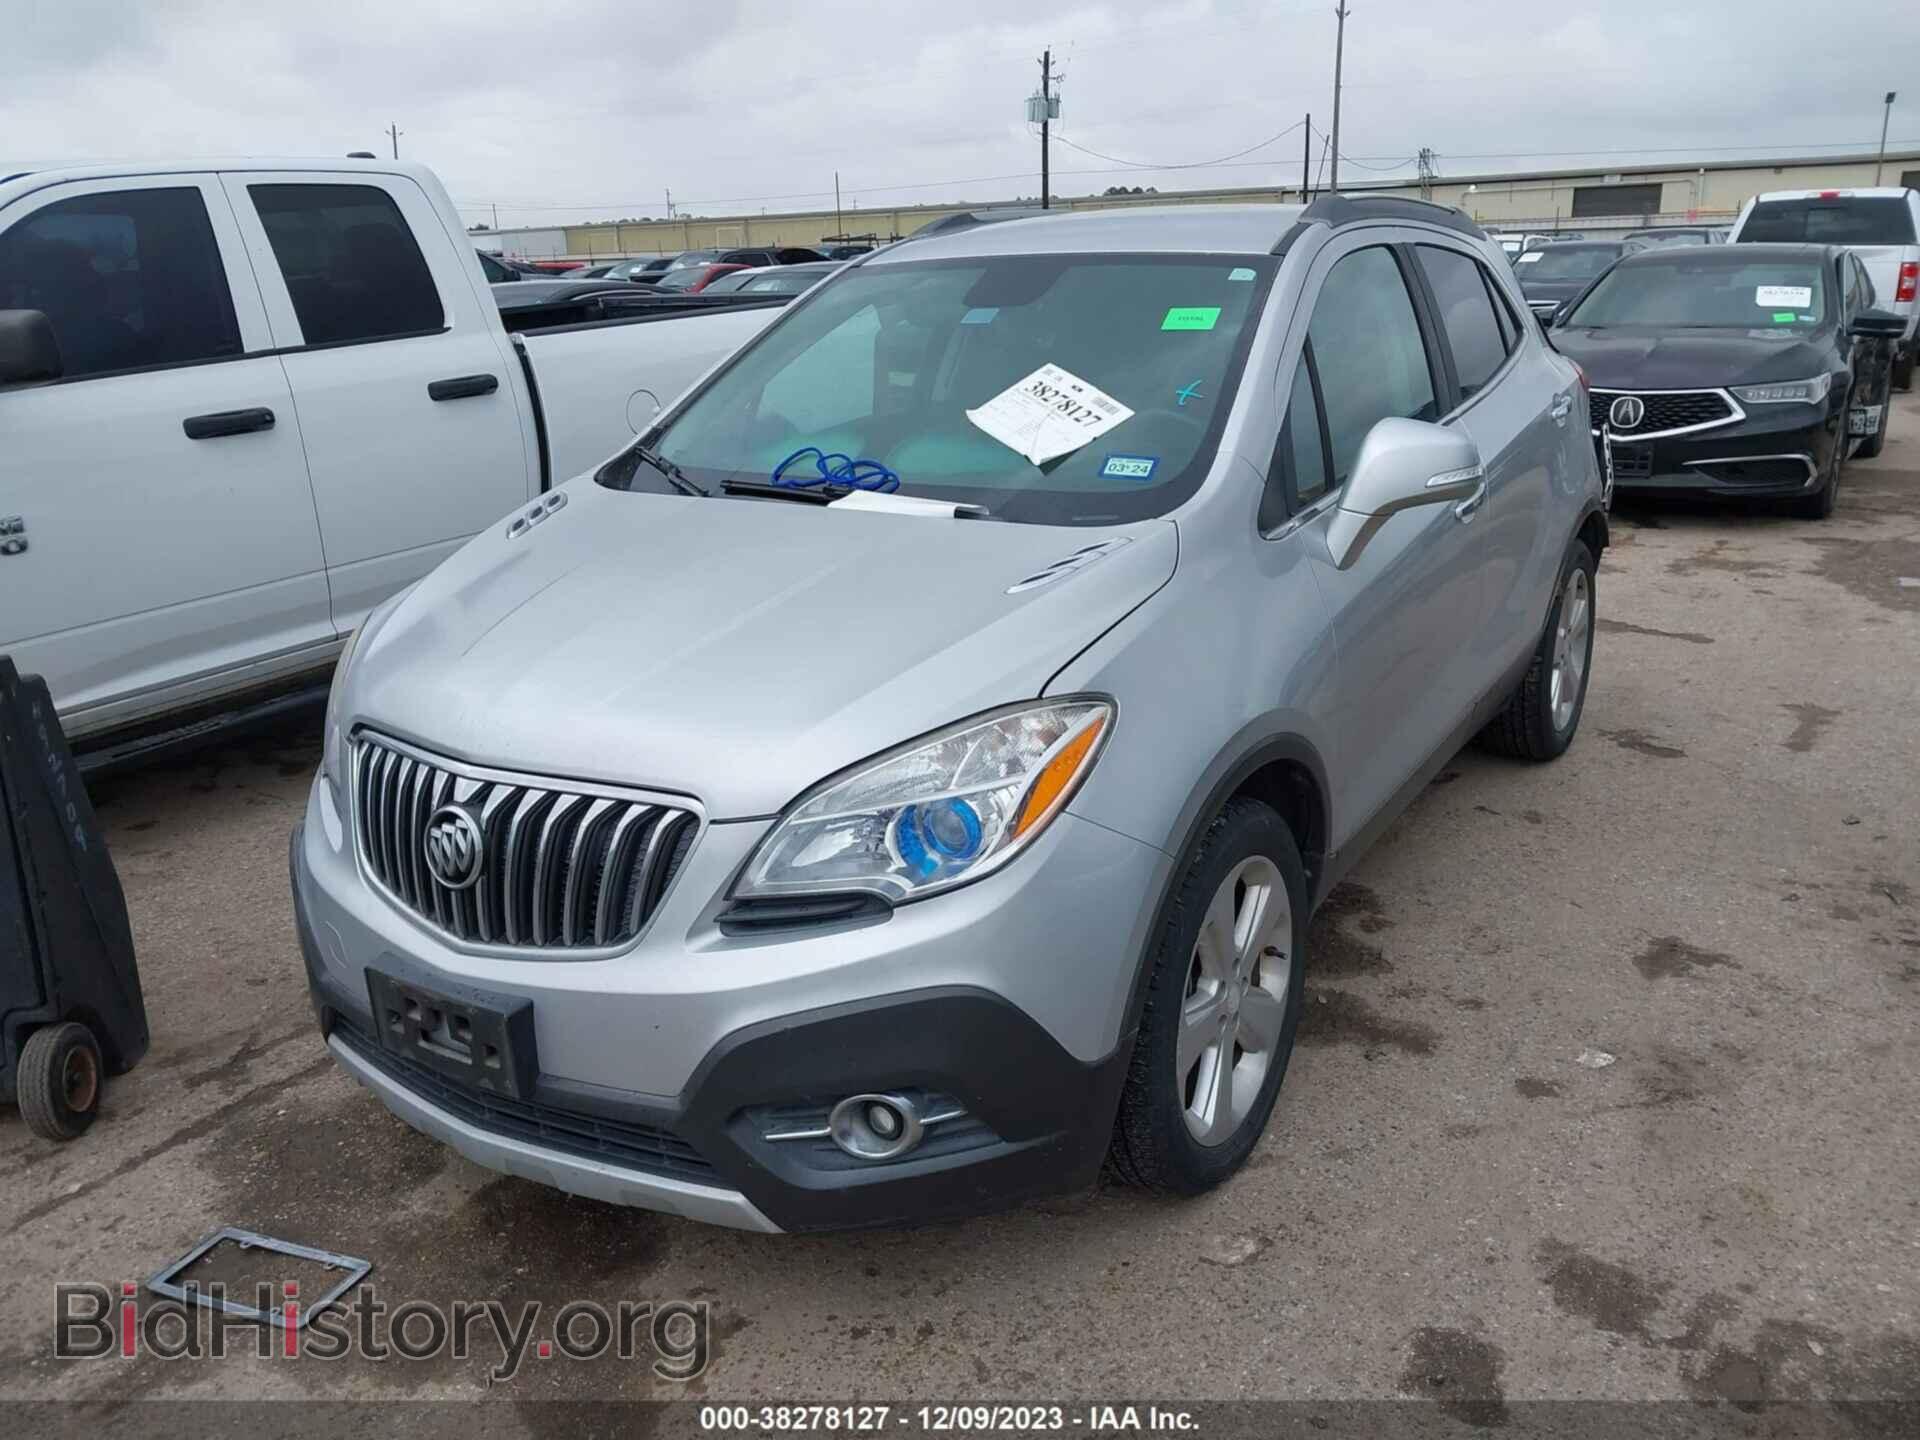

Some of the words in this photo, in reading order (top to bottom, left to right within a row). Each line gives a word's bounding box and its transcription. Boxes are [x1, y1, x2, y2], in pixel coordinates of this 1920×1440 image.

[1024, 381, 1103, 428] 38278127
[1108, 463, 1126, 473] 03
[1131, 464, 1149, 474] 24
